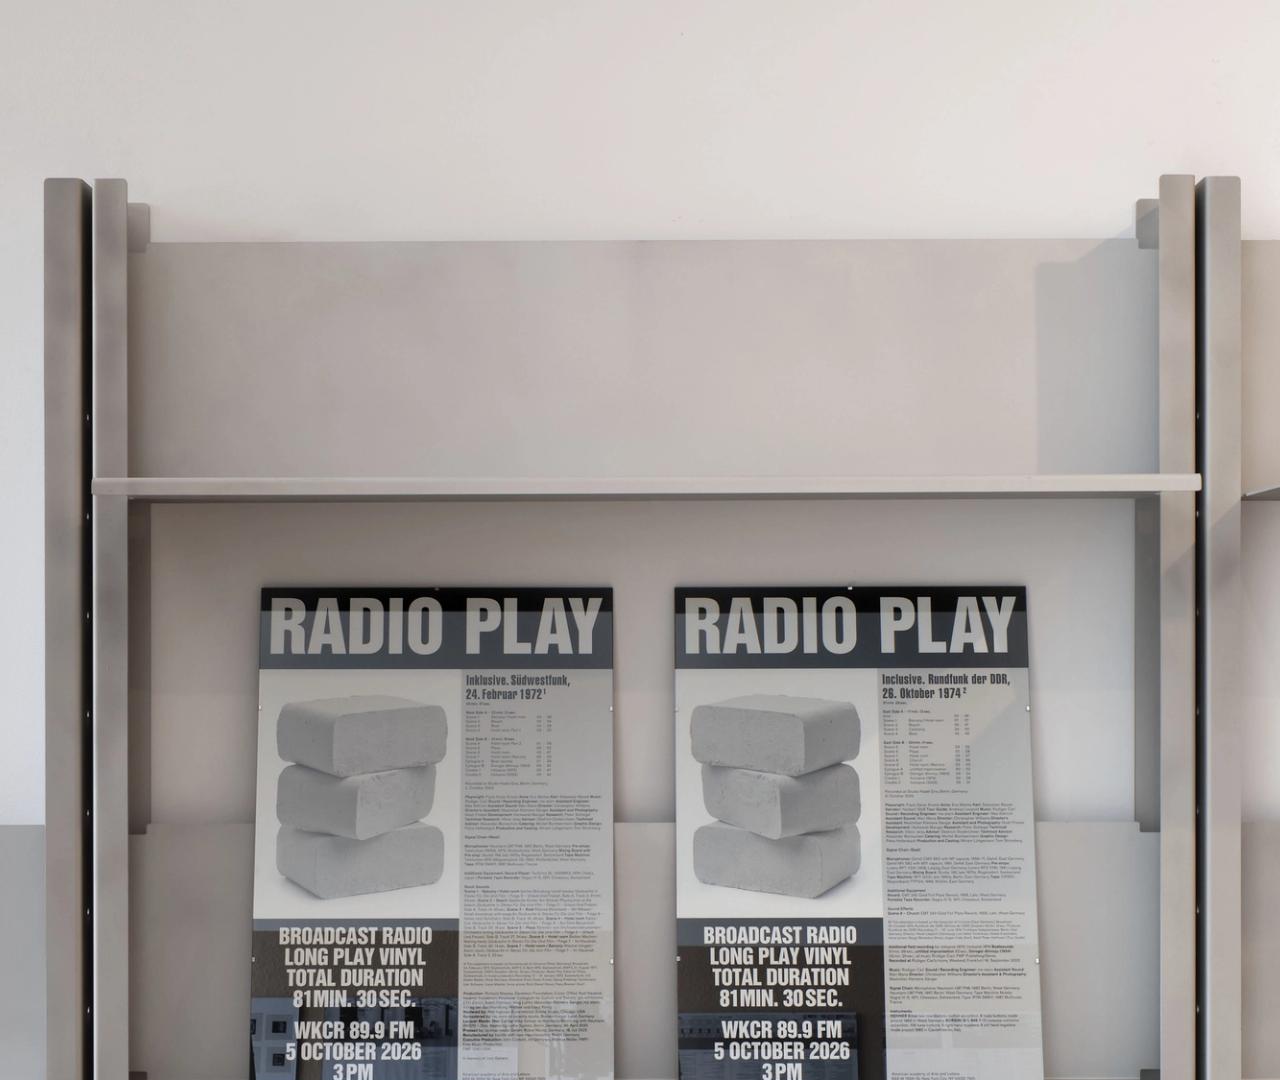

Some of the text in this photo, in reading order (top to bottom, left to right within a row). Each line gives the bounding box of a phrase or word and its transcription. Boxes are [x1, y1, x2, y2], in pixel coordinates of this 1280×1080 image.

[270, 598, 602, 655] RADIO PLAY
[685, 597, 1016, 654] RADIO PLAY
[467, 674, 570, 687] Inklusive. Südwestfunk,
[882, 674, 1010, 685] Inclusive. Rundfunk der DDR,
[466, 689, 480, 699] 24.
[482, 689, 517, 699] Februar
[900, 688, 935, 698] Oktober
[279, 927, 432, 944] BROADCAST RADIO
[704, 926, 856, 944] BROADCAST RADIO
[285, 948, 426, 965] LONG PLAY VINYL
[711, 947, 851, 965] LONG PLAY VINYL
[287, 969, 423, 986] TOTAL DURATION
[712, 968, 849, 986] TOTAL DURATION
[294, 1021, 414, 1039] WKCR 89.9 FM
[722, 1021, 841, 1038] WKCR 89.9 FM
[286, 1042, 421, 1060] 5 OCTOBER 2026
[714, 1042, 850, 1060] 5 OCTOBER 2026
